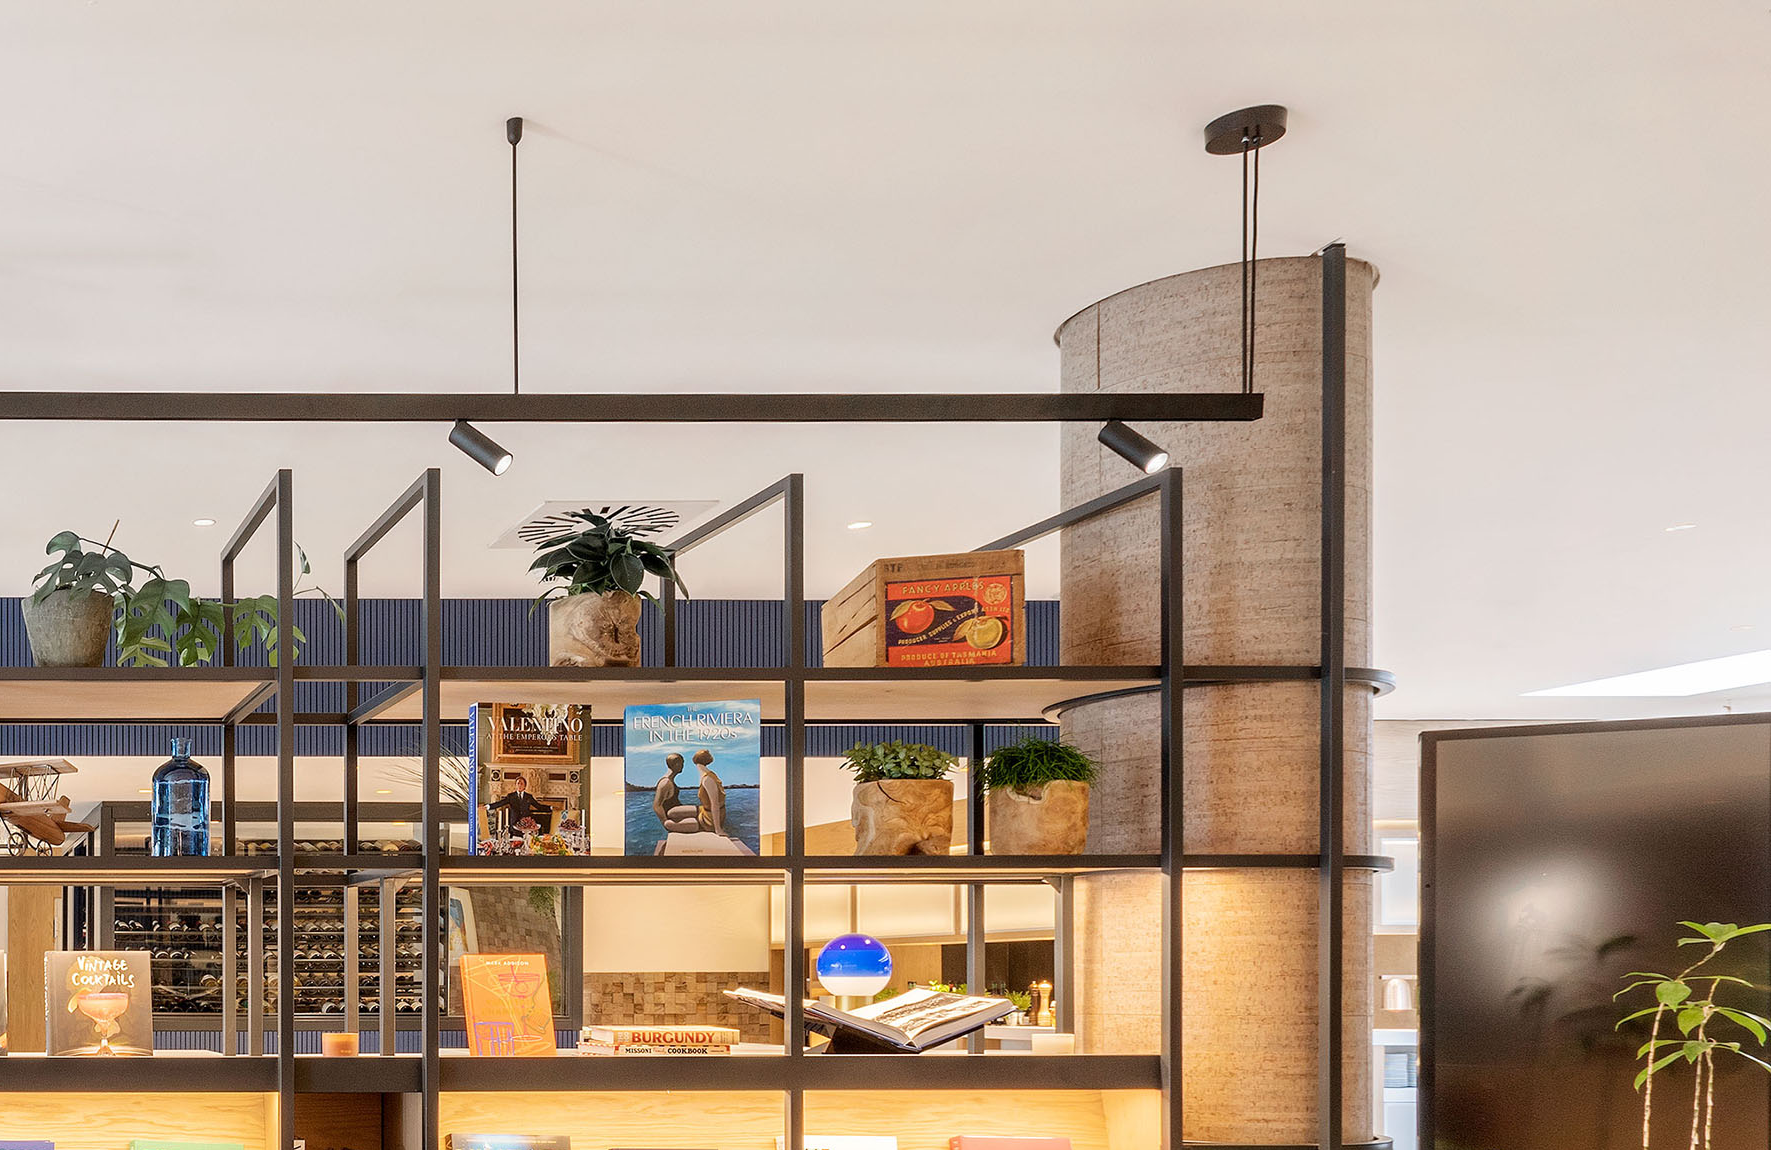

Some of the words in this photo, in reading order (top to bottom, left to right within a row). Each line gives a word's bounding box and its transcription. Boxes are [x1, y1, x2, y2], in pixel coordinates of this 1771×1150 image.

[902, 583, 942, 594] FANCY
[901, 653, 937, 662] PRODUCE
[951, 650, 997, 659] TASMANIA
[487, 716, 583, 733] VALENTINO
[633, 714, 693, 730] FRENCH
[696, 711, 754, 727] RIVIERA
[648, 729, 665, 743] IN
[666, 728, 696, 742] THE
[697, 726, 738, 741] 1920s
[632, 1032, 715, 1044] BURGUNDY
[667, 1047, 708, 1055] COOKBOOK
